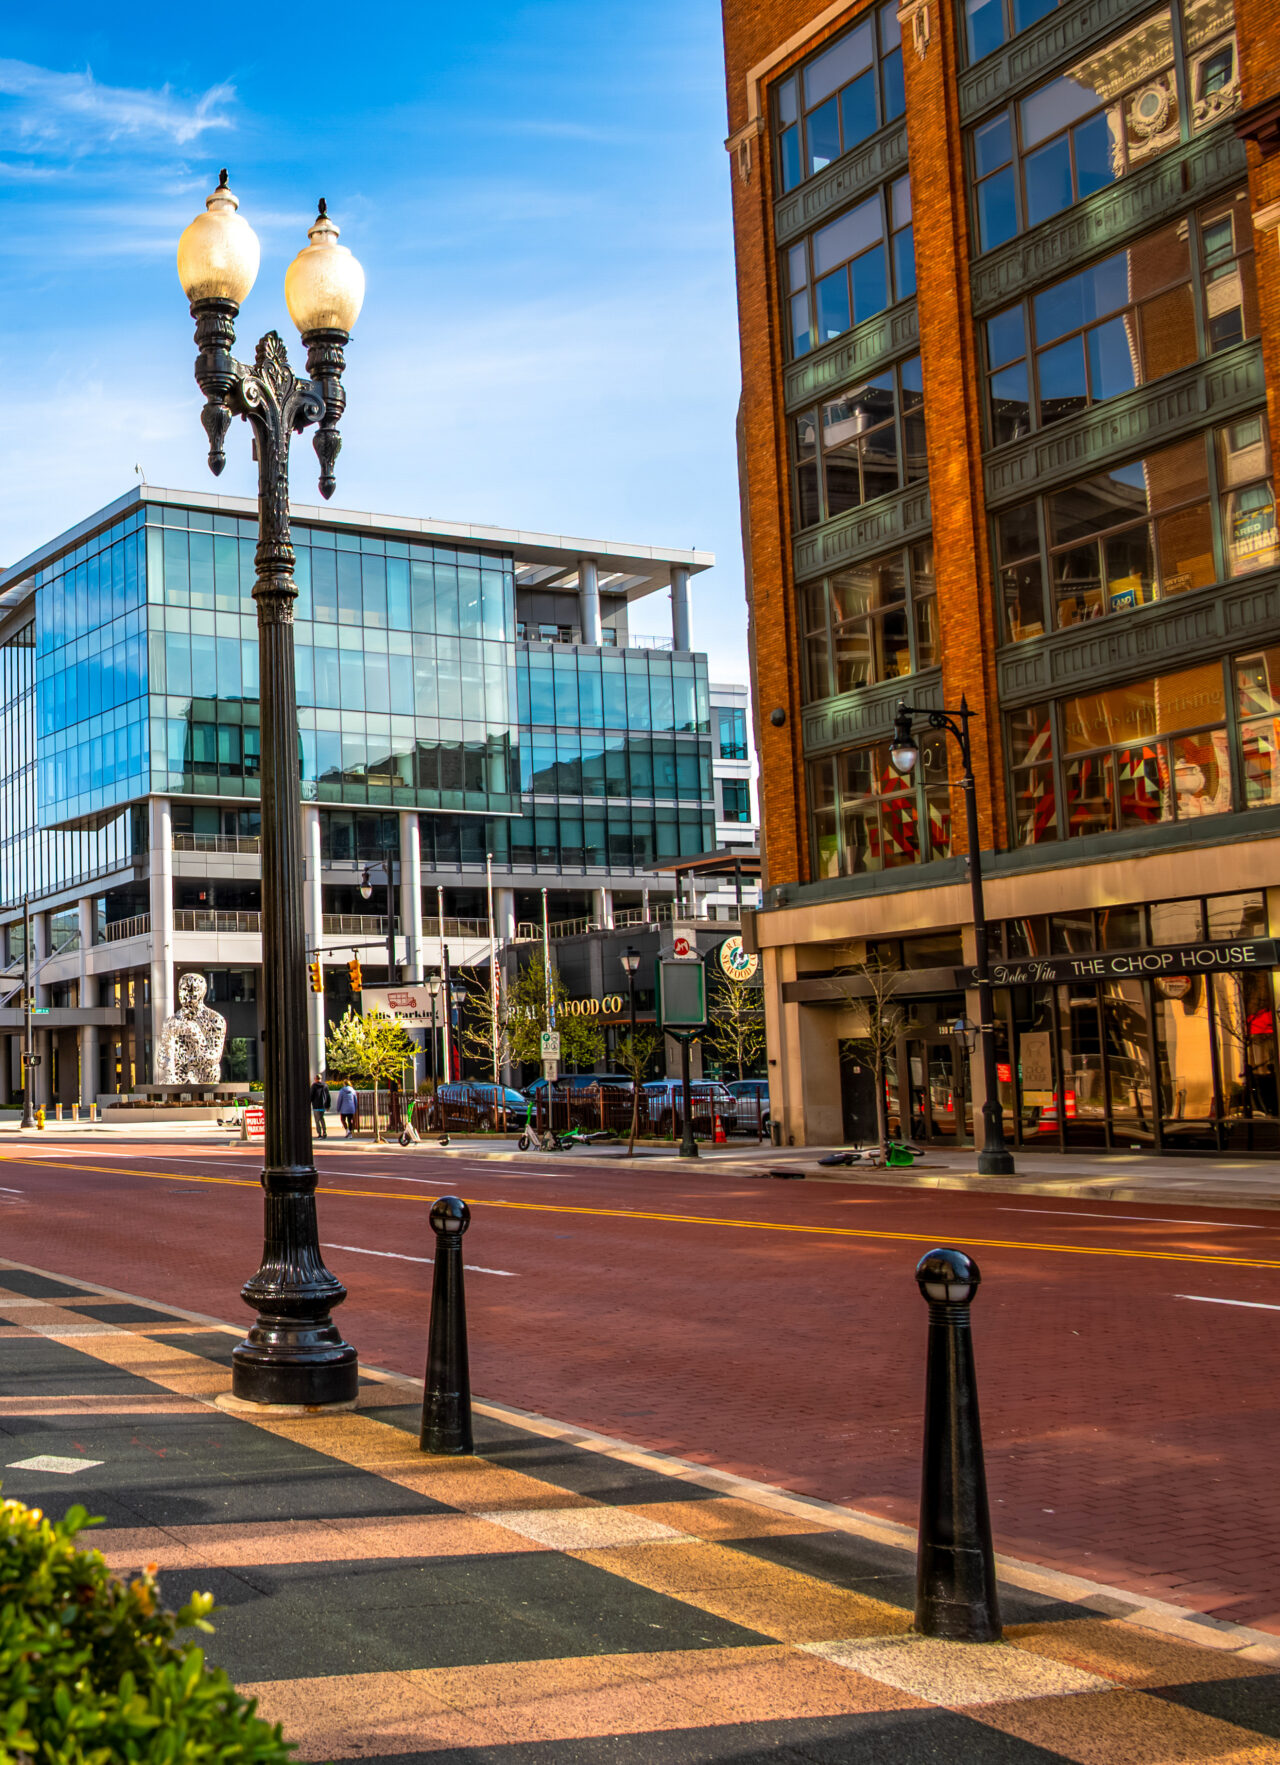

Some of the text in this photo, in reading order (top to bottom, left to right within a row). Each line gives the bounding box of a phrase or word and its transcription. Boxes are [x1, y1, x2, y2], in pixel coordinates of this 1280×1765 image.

[1126, 690, 1222, 723] advrtising
[1071, 959, 1106, 976] THE
[1111, 953, 1173, 972] CHOP
[1181, 946, 1256, 967] HOUSE
[601, 996, 621, 1014] CO
